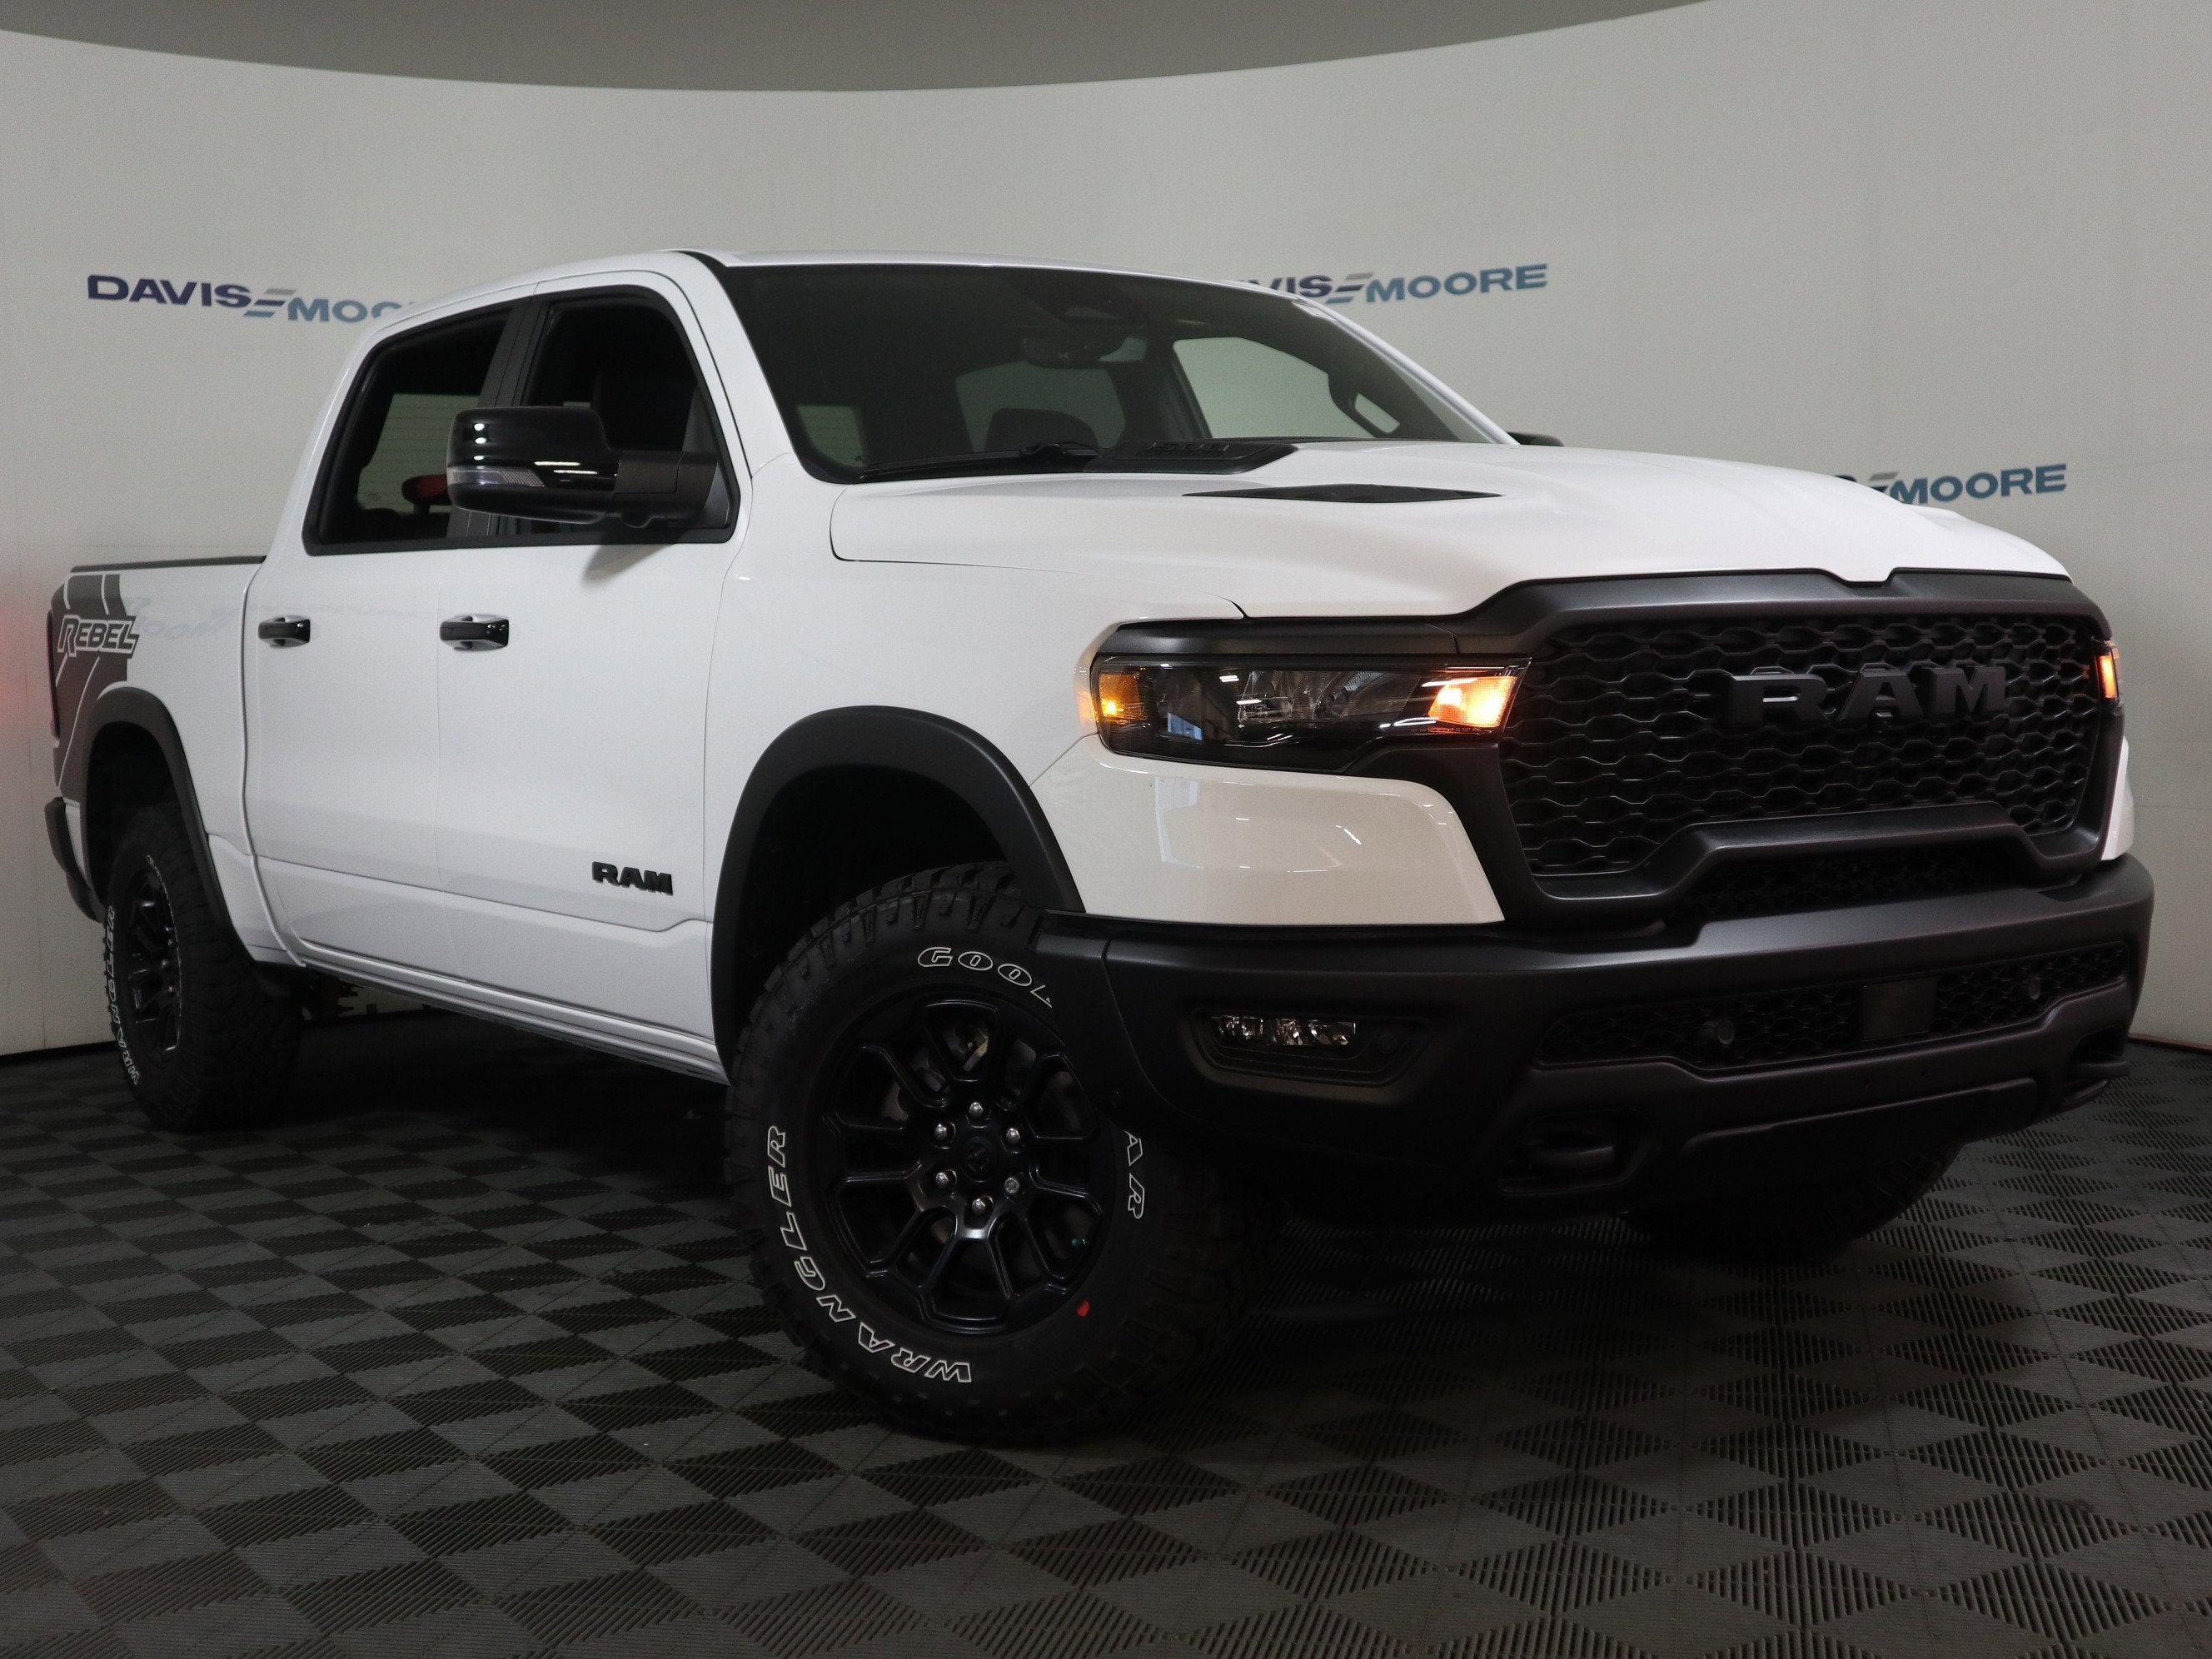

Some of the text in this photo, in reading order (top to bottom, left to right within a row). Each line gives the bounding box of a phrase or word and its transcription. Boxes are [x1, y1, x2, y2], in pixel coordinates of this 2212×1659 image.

[87, 275, 252, 308] DAVIS
[1366, 263, 1548, 302] MOORE
[1890, 463, 2067, 505] MOORE
[57, 614, 137, 658] REBEL
[1730, 665, 2007, 726] RAM
[591, 860, 674, 896] RAM
[106, 904, 140, 1085] WRANGLER
[766, 1125, 972, 1383] WRANGLER
